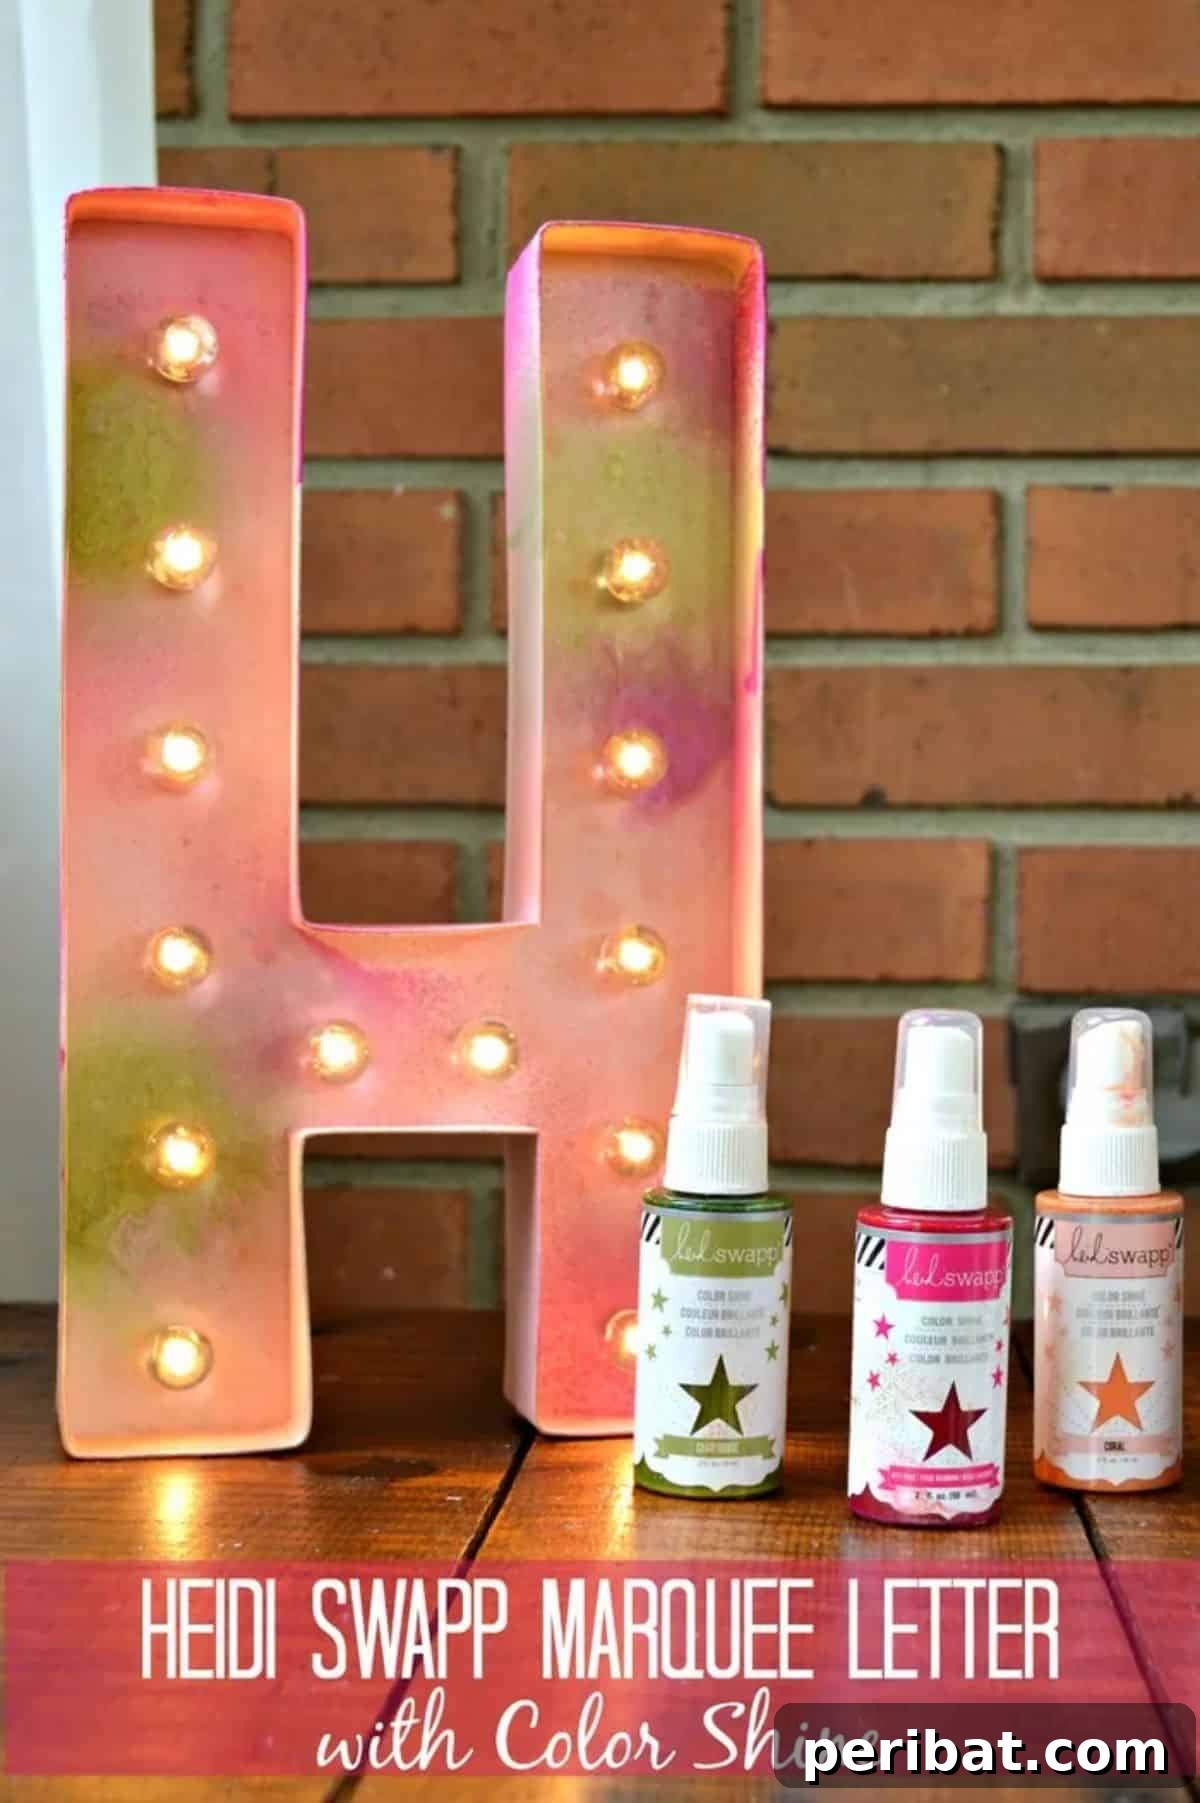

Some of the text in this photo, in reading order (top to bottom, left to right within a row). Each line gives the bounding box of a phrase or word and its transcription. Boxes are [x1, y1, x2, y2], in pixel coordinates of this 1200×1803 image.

[714, 1247, 778, 1268] swapp
[1108, 1248, 1171, 1269] swapp
[943, 1270, 1004, 1293] swapp
